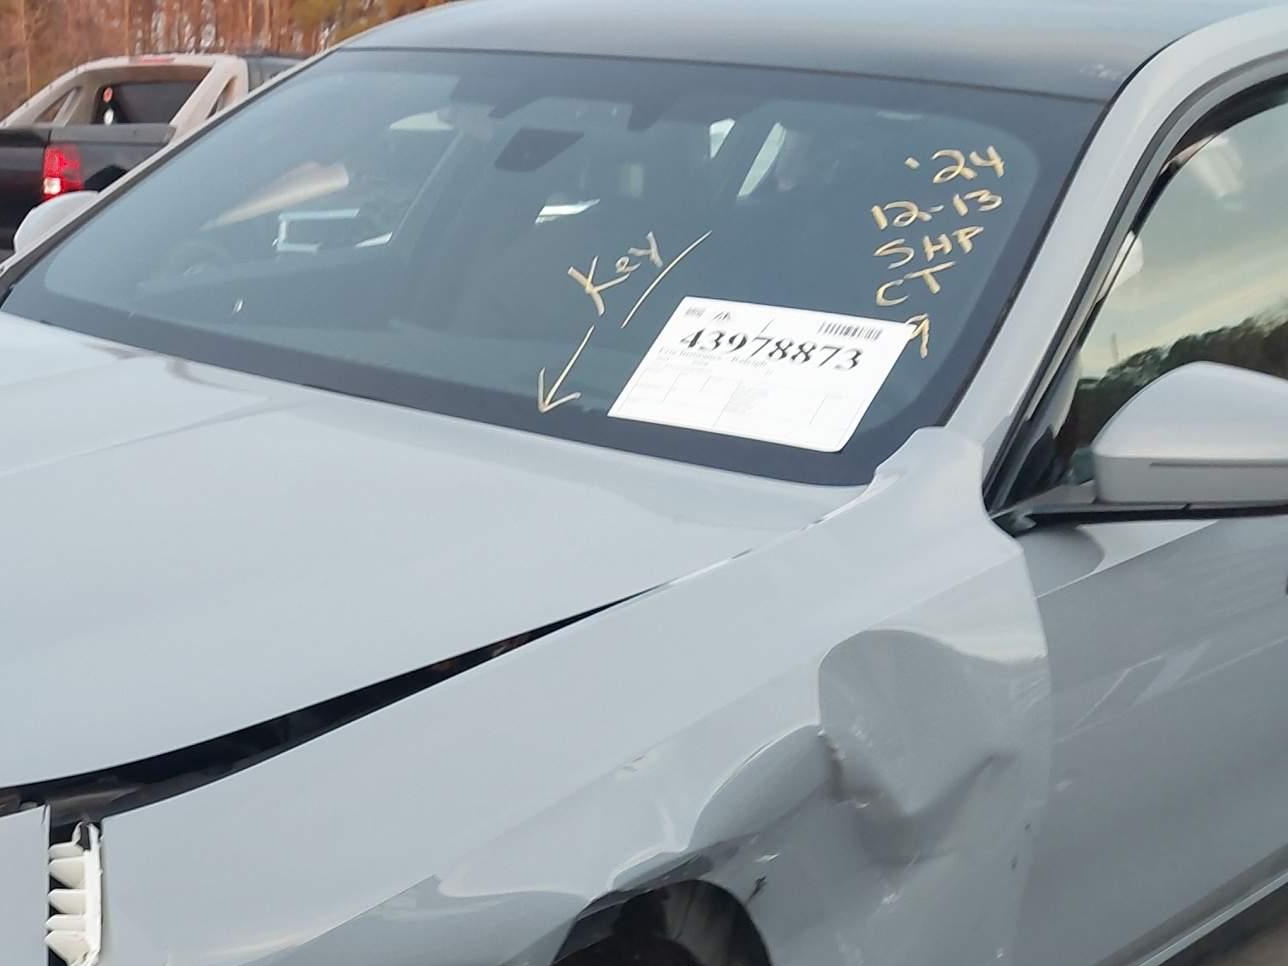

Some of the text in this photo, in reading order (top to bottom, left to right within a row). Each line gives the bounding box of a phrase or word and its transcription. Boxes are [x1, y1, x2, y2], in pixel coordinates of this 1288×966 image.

[870, 189, 1003, 231] 12-13
[875, 260, 957, 307] CT
[679, 327, 865, 371] 43978873
